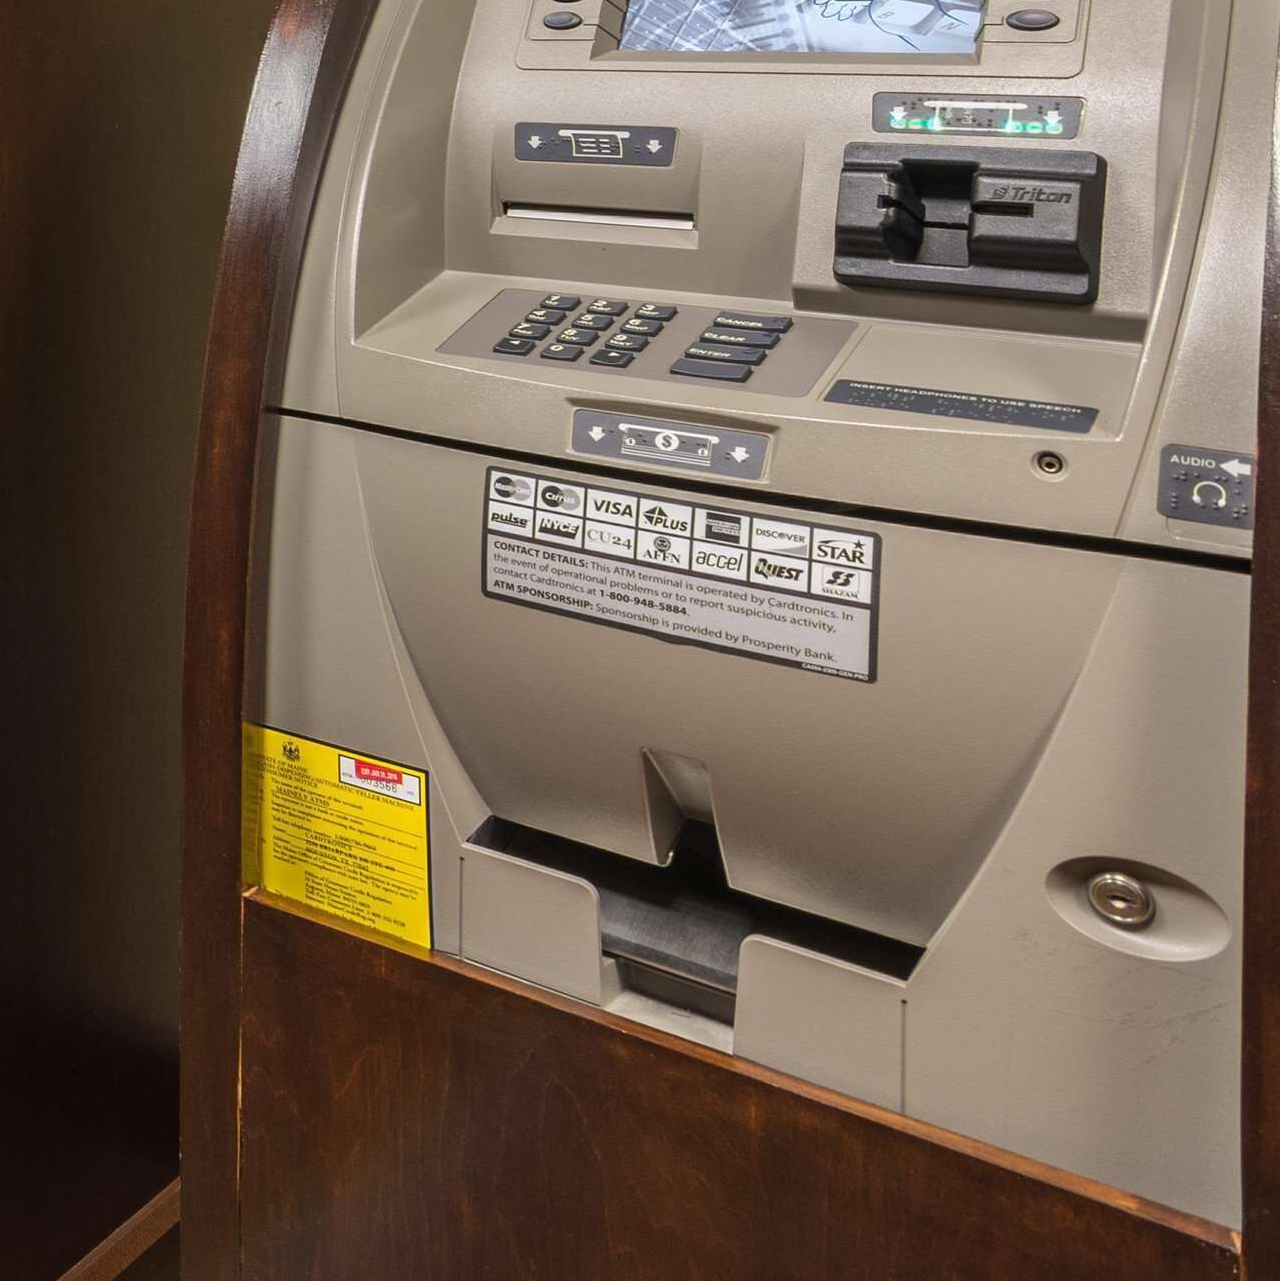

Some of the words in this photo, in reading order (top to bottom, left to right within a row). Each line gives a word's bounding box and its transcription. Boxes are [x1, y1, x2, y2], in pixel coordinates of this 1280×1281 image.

[1011, 185, 1072, 204] Triton
[716, 317, 764, 328] CANCEL
[703, 332, 746, 342] CLEAR
[689, 347, 732, 358] ENTER
[850, 382, 892, 392] INSERT
[894, 387, 978, 402] HEADPHONES
[1001, 399, 1026, 408] USE
[1029, 403, 1082, 414] SPEECH
[1170, 454, 1216, 469] AUDIO
[593, 498, 633, 517] VISA
[490, 512, 528, 527] pulse
[540, 518, 578, 533] NYCE
[653, 516, 688, 531] PLUS
[586, 529, 632, 549] CU24
[755, 528, 805, 543] DISCOVER
[642, 549, 680, 564] AFFN
[695, 549, 743, 572] accel
[816, 544, 865, 564] STAR
[493, 540, 540, 557] CONTACT
[541, 551, 588, 567] DETAILS:
[590, 561, 611, 572] This
[612, 566, 636, 578] ATM
[637, 571, 682, 587] terminal
[685, 581, 694, 590] is
[696, 583, 747, 603] operated
[750, 594, 765, 607] by
[767, 597, 838, 618] Cardtronics.
[841, 612, 853, 621] In
[492, 566, 528, 580] contact
[528, 573, 583, 592] Cardtronics
[585, 587, 596, 595] at
[599, 589, 690, 616] 1-800-948-5884.
[493, 553, 509, 563] the
[510, 558, 536, 569] event
[538, 563, 549, 572] of
[550, 566, 607, 585] operational
[609, 579, 659, 596] problems
[675, 593, 687, 602] to
[689, 596, 725, 611] report
[727, 603, 786, 624] suspicious
[789, 615, 836, 634] activity,
[493, 580, 514, 591] ATM
[516, 585, 594, 609] SPONSORSHIP:
[595, 603, 659, 625] Sponsorship
[661, 618, 669, 626] is
[672, 620, 722, 640] provided
[724, 631, 739, 643] by
[741, 635, 800, 657] Prosperity
[804, 648, 837, 662] Bank.
